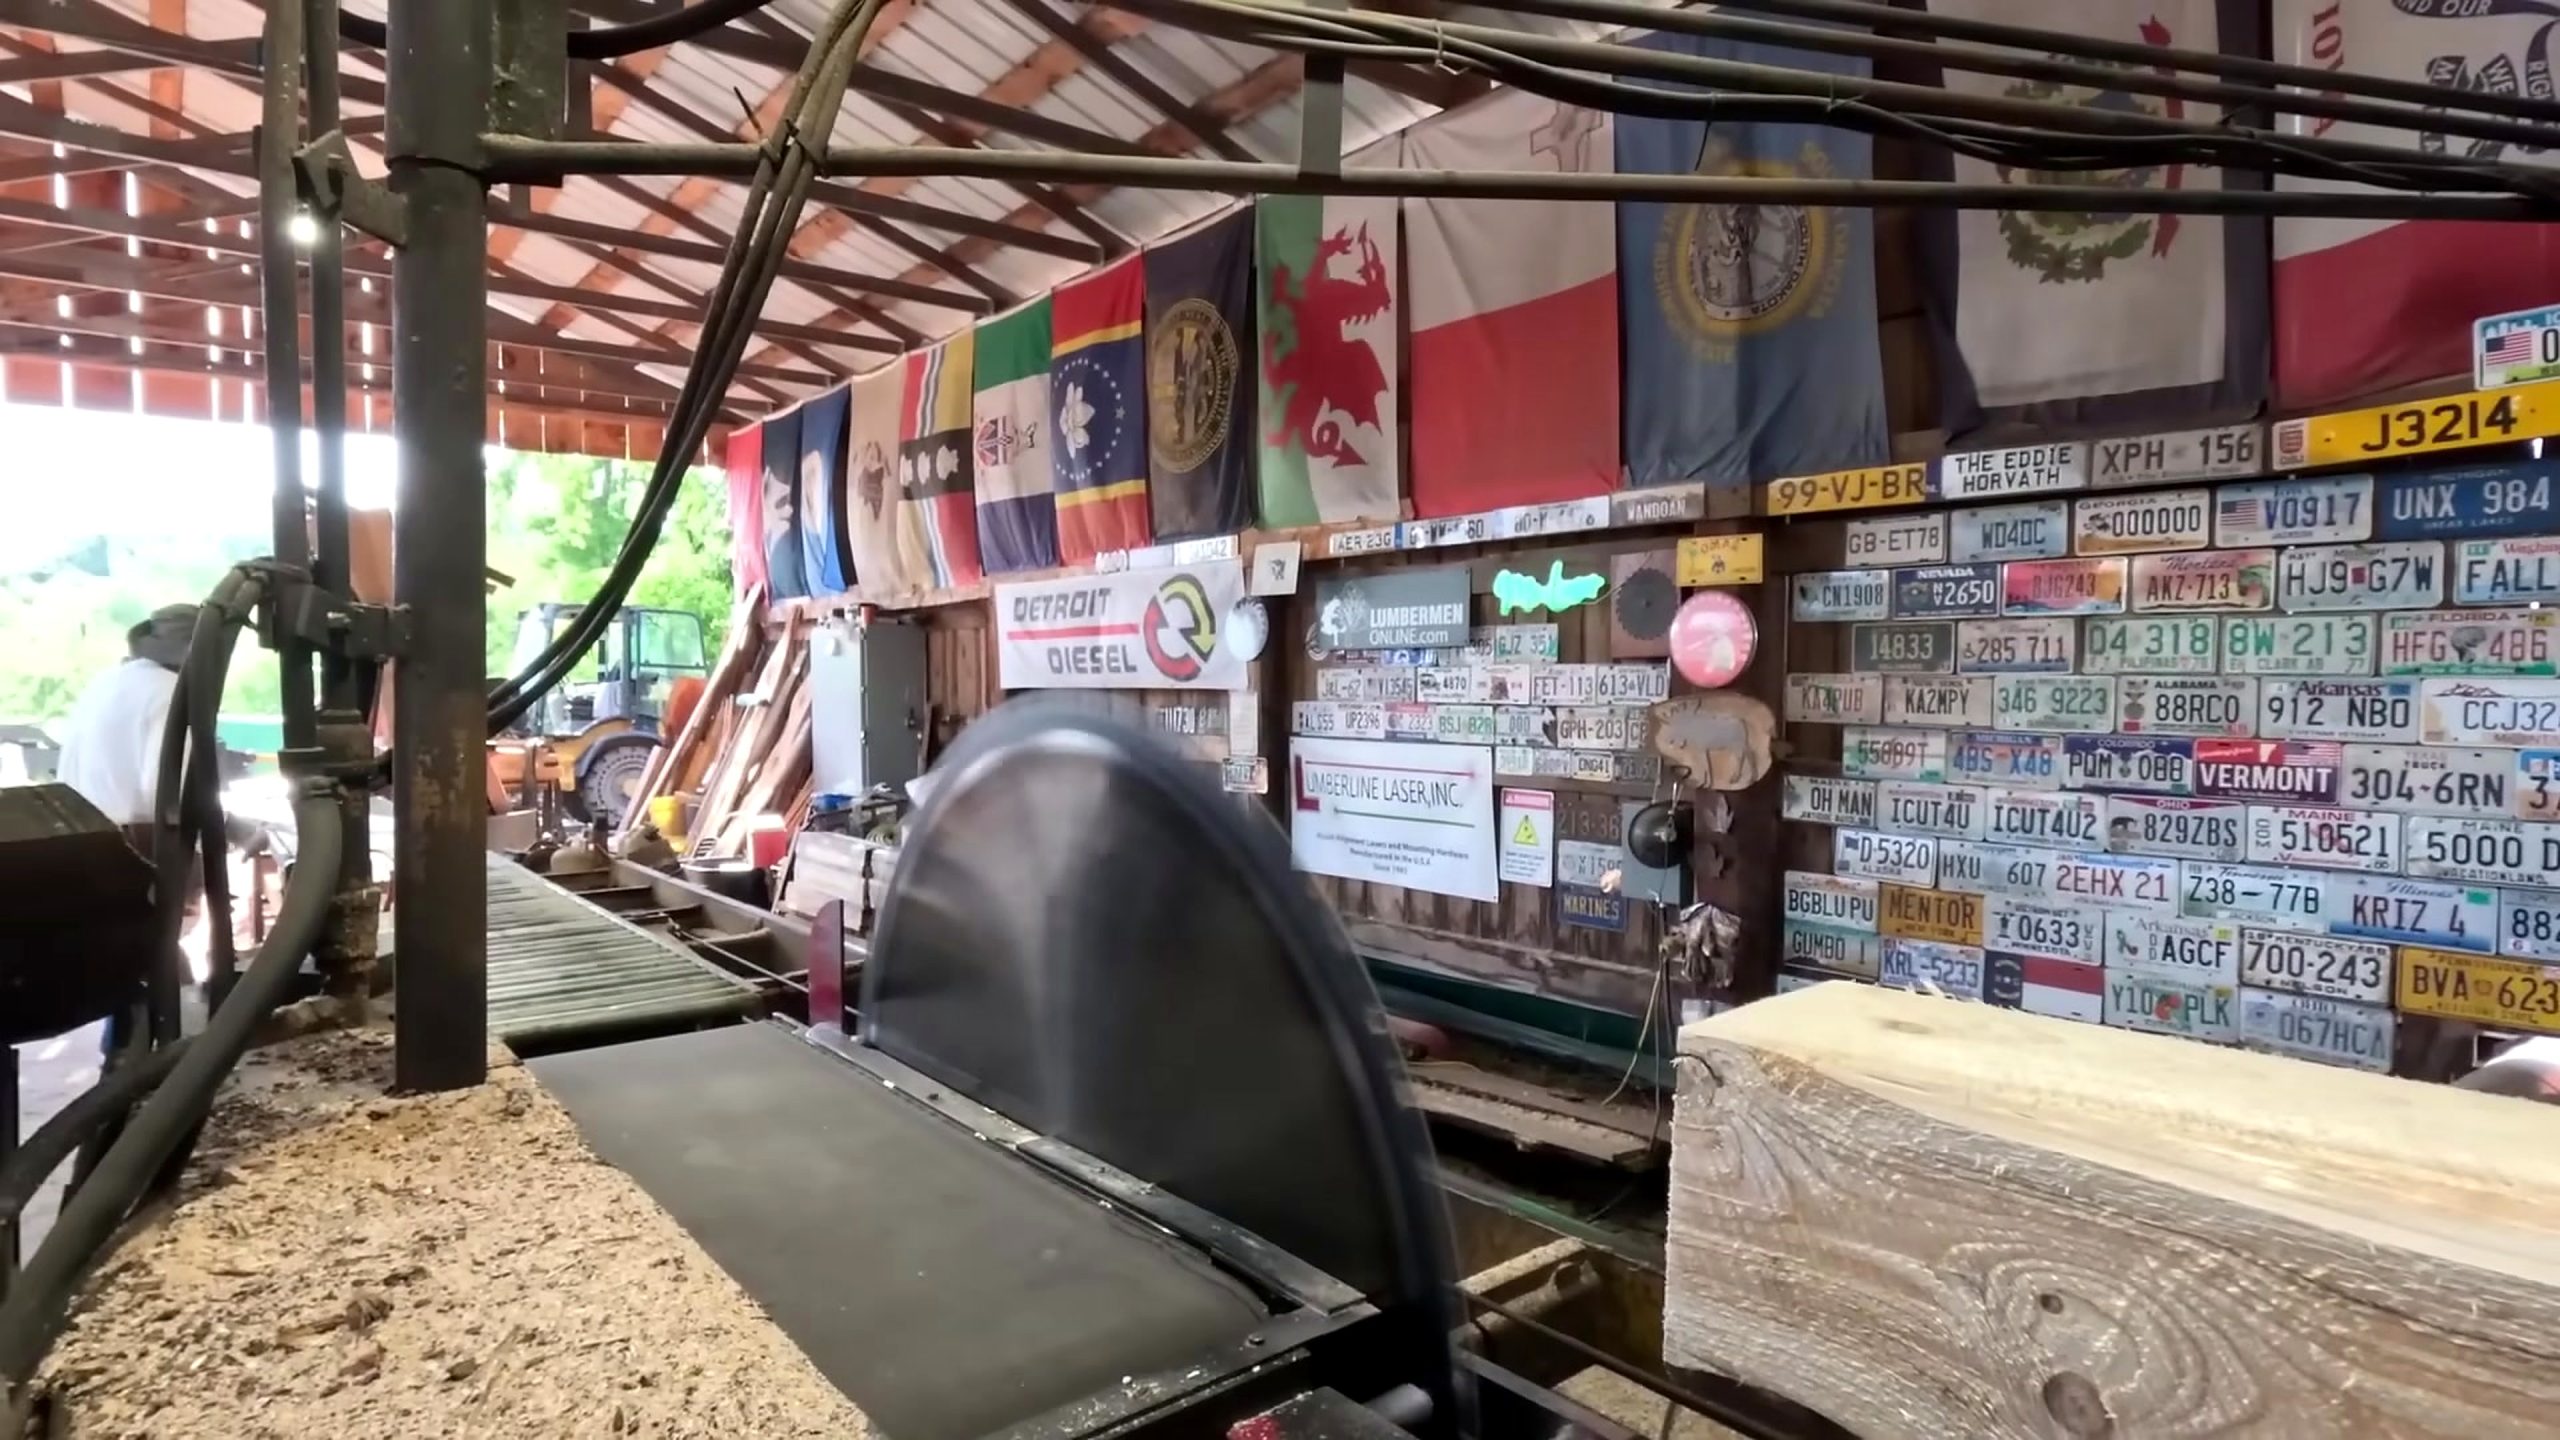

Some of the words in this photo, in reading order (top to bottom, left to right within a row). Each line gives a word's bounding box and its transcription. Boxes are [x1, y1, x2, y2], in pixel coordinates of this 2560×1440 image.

[2441, 0, 2493, 15] OUR
[2361, 395, 2518, 453] J3214
[1955, 457, 1991, 474] THE
[2004, 446, 2072, 469] EDDIE
[2101, 439, 2165, 475] XPH
[2199, 432, 2254, 466] 156
[1778, 467, 1927, 510] 99-VJ-BR
[1962, 468, 2061, 493] HORVATH
[1626, 499, 1687, 523] WANDOAN
[2079, 497, 2158, 511] GEORGIA
[2264, 491, 2362, 531] V0917
[2392, 483, 2458, 521] UNX
[2482, 476, 2551, 515] 984
[1337, 534, 1363, 552] AER
[1917, 566, 1976, 580] NEVADA
[2286, 560, 2349, 597] HJ9
[2368, 555, 2434, 593] G7W
[1013, 588, 1112, 623] DETROIT
[1944, 579, 1995, 606] 2650
[1370, 603, 1464, 628] LUMBERMEN
[2427, 611, 2512, 623] FLORIDA
[1369, 629, 1449, 646] ONLINE.com
[1870, 629, 1934, 661] 14833
[1977, 636, 2017, 664] 285
[2028, 635, 2066, 663] 711
[2144, 622, 2210, 656] 318
[2229, 621, 2276, 657] 8W
[2292, 621, 2367, 657] 213
[2392, 630, 2448, 663] HFG
[2488, 628, 2548, 663] 486
[1047, 644, 1139, 674] DIESEL
[2153, 679, 2218, 690] ALABAMA
[2295, 681, 2385, 697] Arkansas
[1998, 686, 2038, 714] 346
[2050, 686, 2108, 715] 9223
[2267, 696, 2325, 727] 912
[2463, 700, 2560, 732] CCJ32
[1559, 719, 1624, 740] GPH-203
[2198, 763, 2333, 793] VERMONT
[2528, 775, 2560, 810] 3
[1810, 786, 1833, 812] OH
[1838, 789, 1873, 817] MAN
[1891, 798, 1971, 829] ICUT4U
[2155, 799, 2192, 811] OHIO
[2287, 809, 2357, 822] MAINE
[1993, 804, 2098, 841] ICUT4U2
[2461, 821, 2525, 835] MAINE
[2281, 819, 2389, 858] 510521
[2426, 831, 2523, 870] 5000
[1942, 853, 1981, 880] HXU
[2006, 861, 2048, 888] 607
[2055, 864, 2125, 898] 2EHX
[2134, 871, 2170, 902] 21
[2386, 881, 2454, 898] Illinois
[1562, 895, 1620, 921] MARINES
[1888, 890, 1976, 930] MENTOR
[2351, 894, 2428, 933] KRIZ
[2448, 904, 2466, 938] 4
[2018, 914, 2080, 949] 0633
[2136, 917, 2209, 937] Arkansas
[2511, 908, 2560, 942] 88
[1792, 930, 1846, 961] GUMBO
[2161, 934, 2232, 969] AGCF
[2275, 936, 2354, 951] KENTUCKY
[2246, 940, 2381, 989] 700-243
[2279, 979, 2349, 996] NELSON
[2412, 964, 2469, 1001] BVA
[2184, 994, 2230, 1027] PLK
